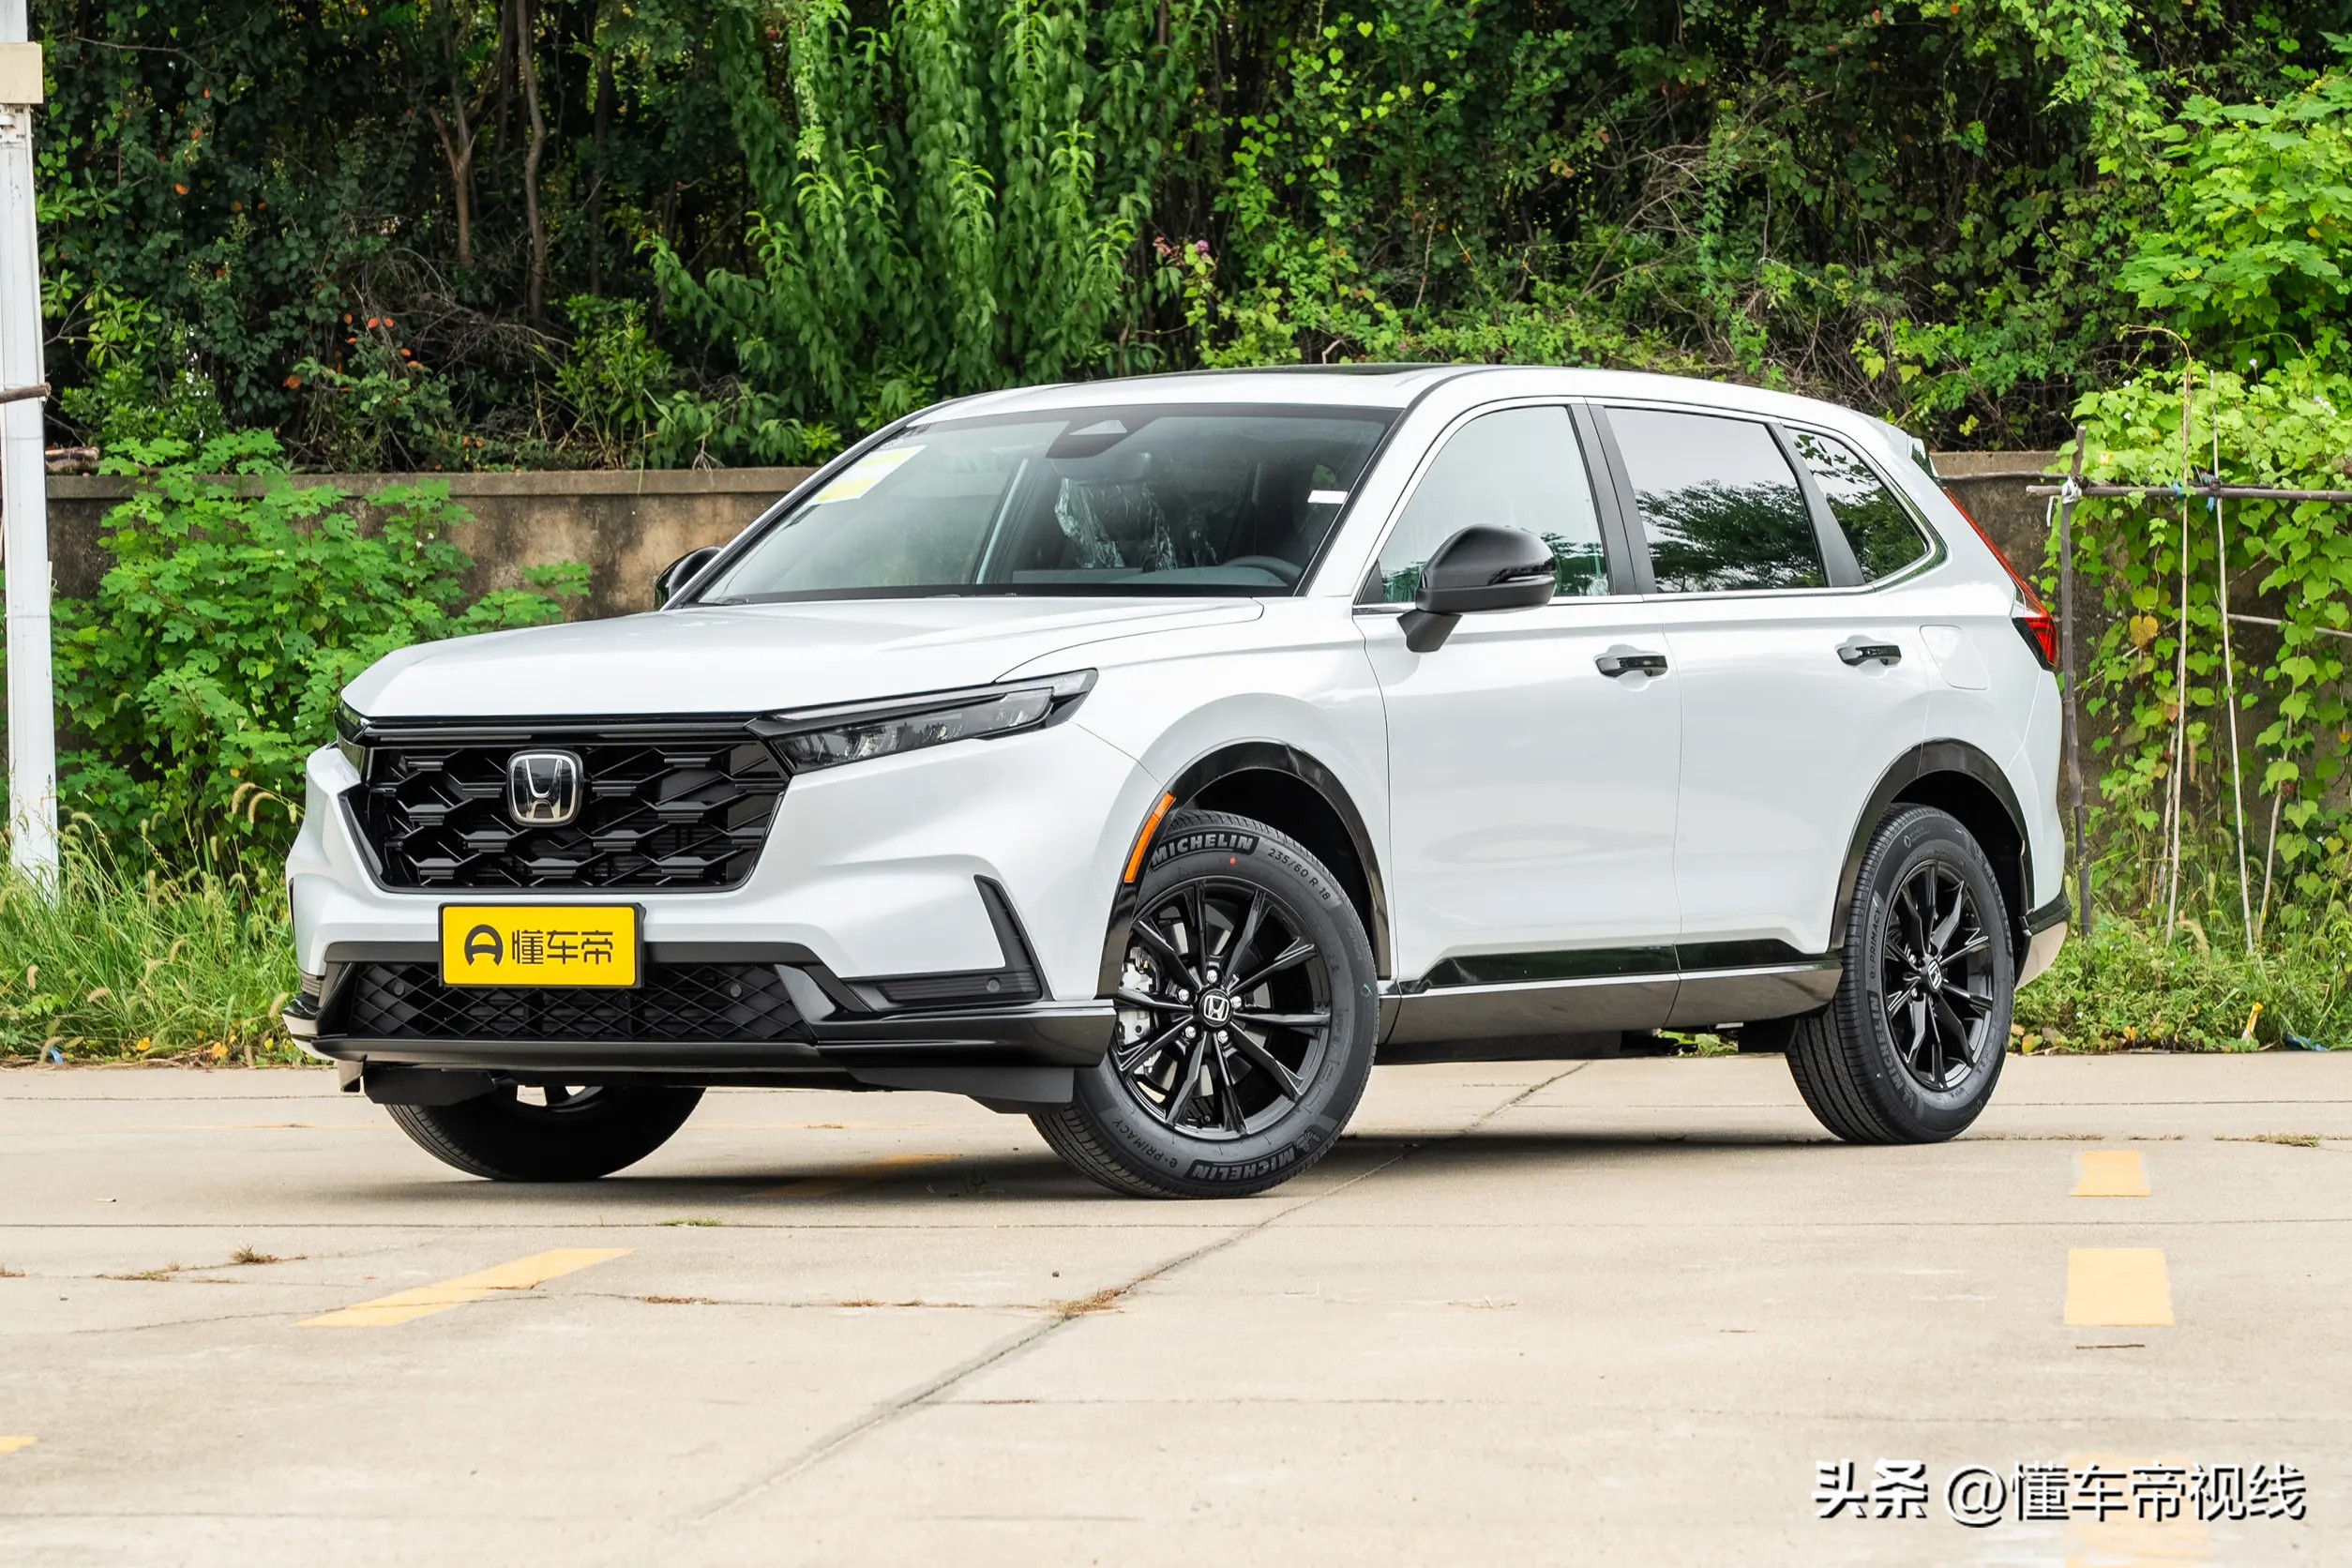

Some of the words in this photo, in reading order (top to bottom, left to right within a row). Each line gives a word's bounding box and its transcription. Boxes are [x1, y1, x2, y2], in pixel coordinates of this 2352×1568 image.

[1152, 833, 1254, 867] MICHELIN
[1268, 848, 1309, 878] 235/60
[1308, 877, 1320, 887] R
[1318, 887, 1332, 901] 18
[511, 929, 613, 965] 懂车帝
[1869, 996, 1905, 1090] MICHELIN
[1192, 1146, 1295, 1180] MICHELIN
